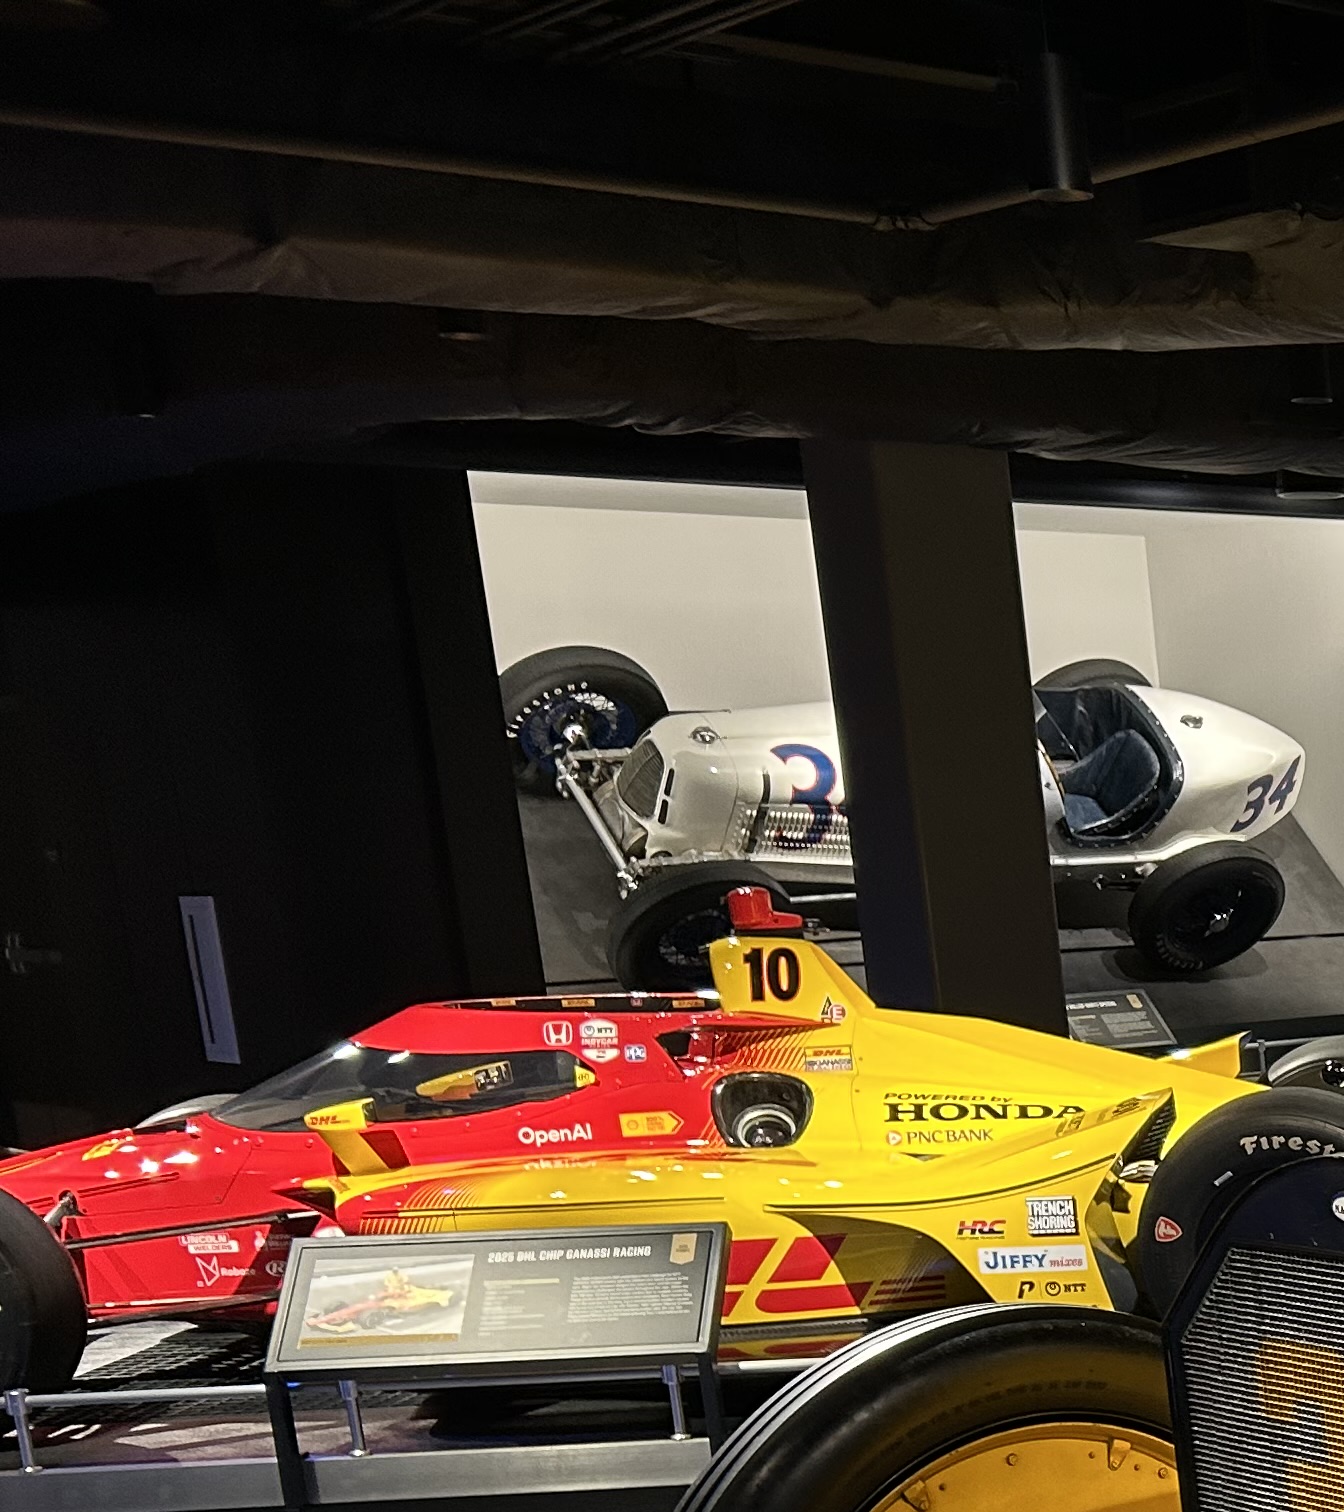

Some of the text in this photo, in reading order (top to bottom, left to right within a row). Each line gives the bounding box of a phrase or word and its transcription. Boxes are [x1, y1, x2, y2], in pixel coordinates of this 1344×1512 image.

[769, 743, 848, 850] 3
[1229, 754, 1302, 833] 34
[743, 946, 802, 1002] 10
[884, 1092, 986, 1102] POWERED
[884, 1102, 1085, 1123] HONDA
[518, 1122, 593, 1147] OpenAI
[1026, 1199, 1074, 1216] TRENCH
[957, 1219, 1006, 1236] HRC
[1027, 1215, 1076, 1231] SHORING
[566, 1247, 611, 1260] GANASSI
[613, 1246, 652, 1258] RACING
[1063, 1283, 1087, 1293] NTT
